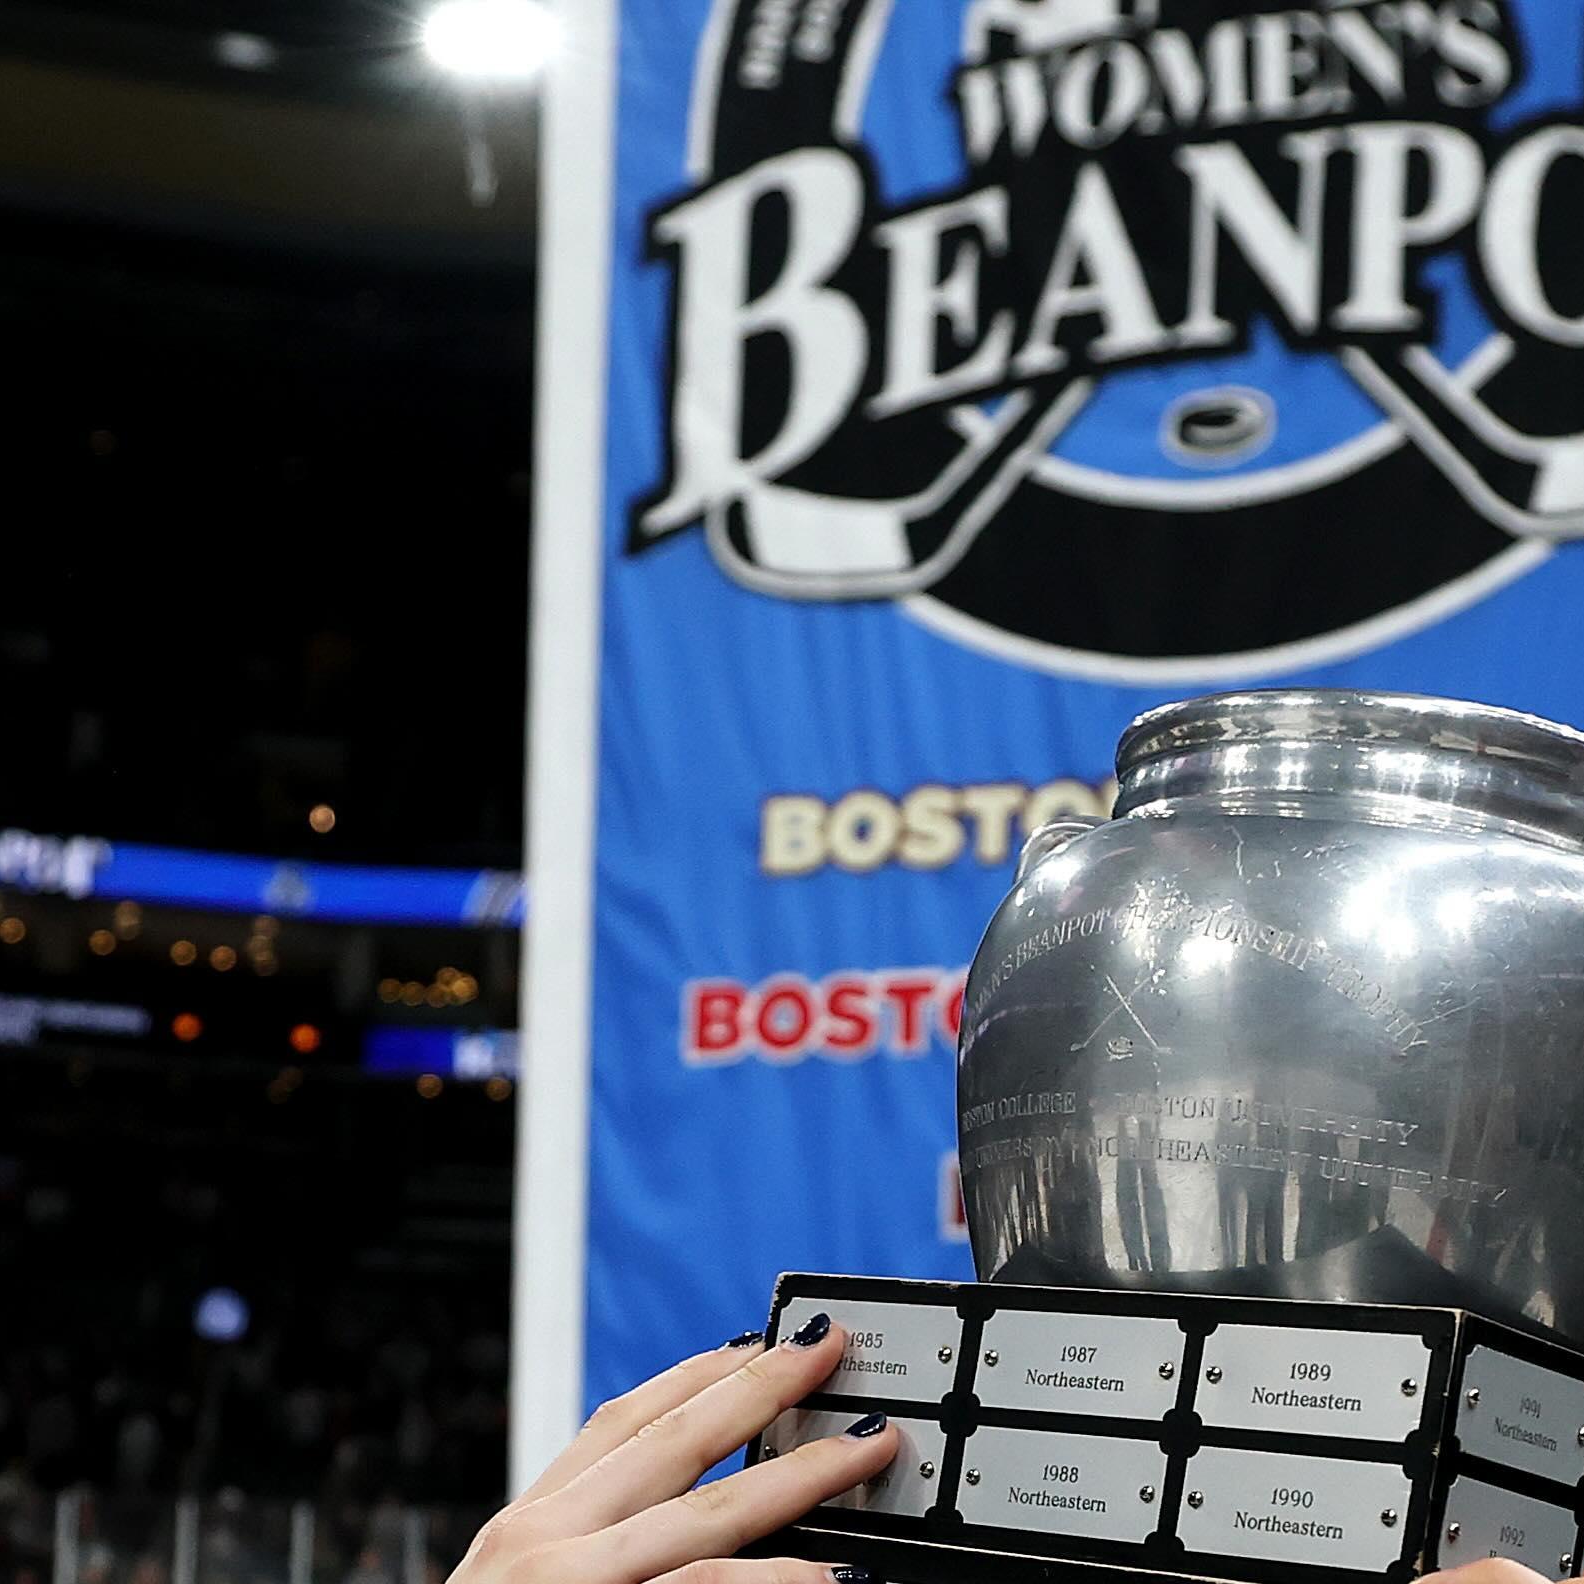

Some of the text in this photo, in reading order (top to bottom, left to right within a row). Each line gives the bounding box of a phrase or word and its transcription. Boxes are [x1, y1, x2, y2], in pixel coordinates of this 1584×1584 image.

[960, 0, 1512, 160] WOMEN'S
[689, 970, 968, 1061] BOST
[848, 1331, 885, 1349] 1985
[1060, 1346, 1098, 1365] 1987
[1025, 1368, 1125, 1393] Northeastern
[1289, 1361, 1332, 1382] 1989
[1251, 1386, 1362, 1412] Northeastern
[1519, 1397, 1542, 1418] 1991
[1494, 1416, 1558, 1452] Northeastern
[1042, 1463, 1079, 1484] 1988
[1007, 1486, 1107, 1513] Northeastern
[1270, 1487, 1315, 1508] 1990
[1233, 1510, 1344, 1540] Northeastern
[1499, 1525, 1526, 1548] 1992
